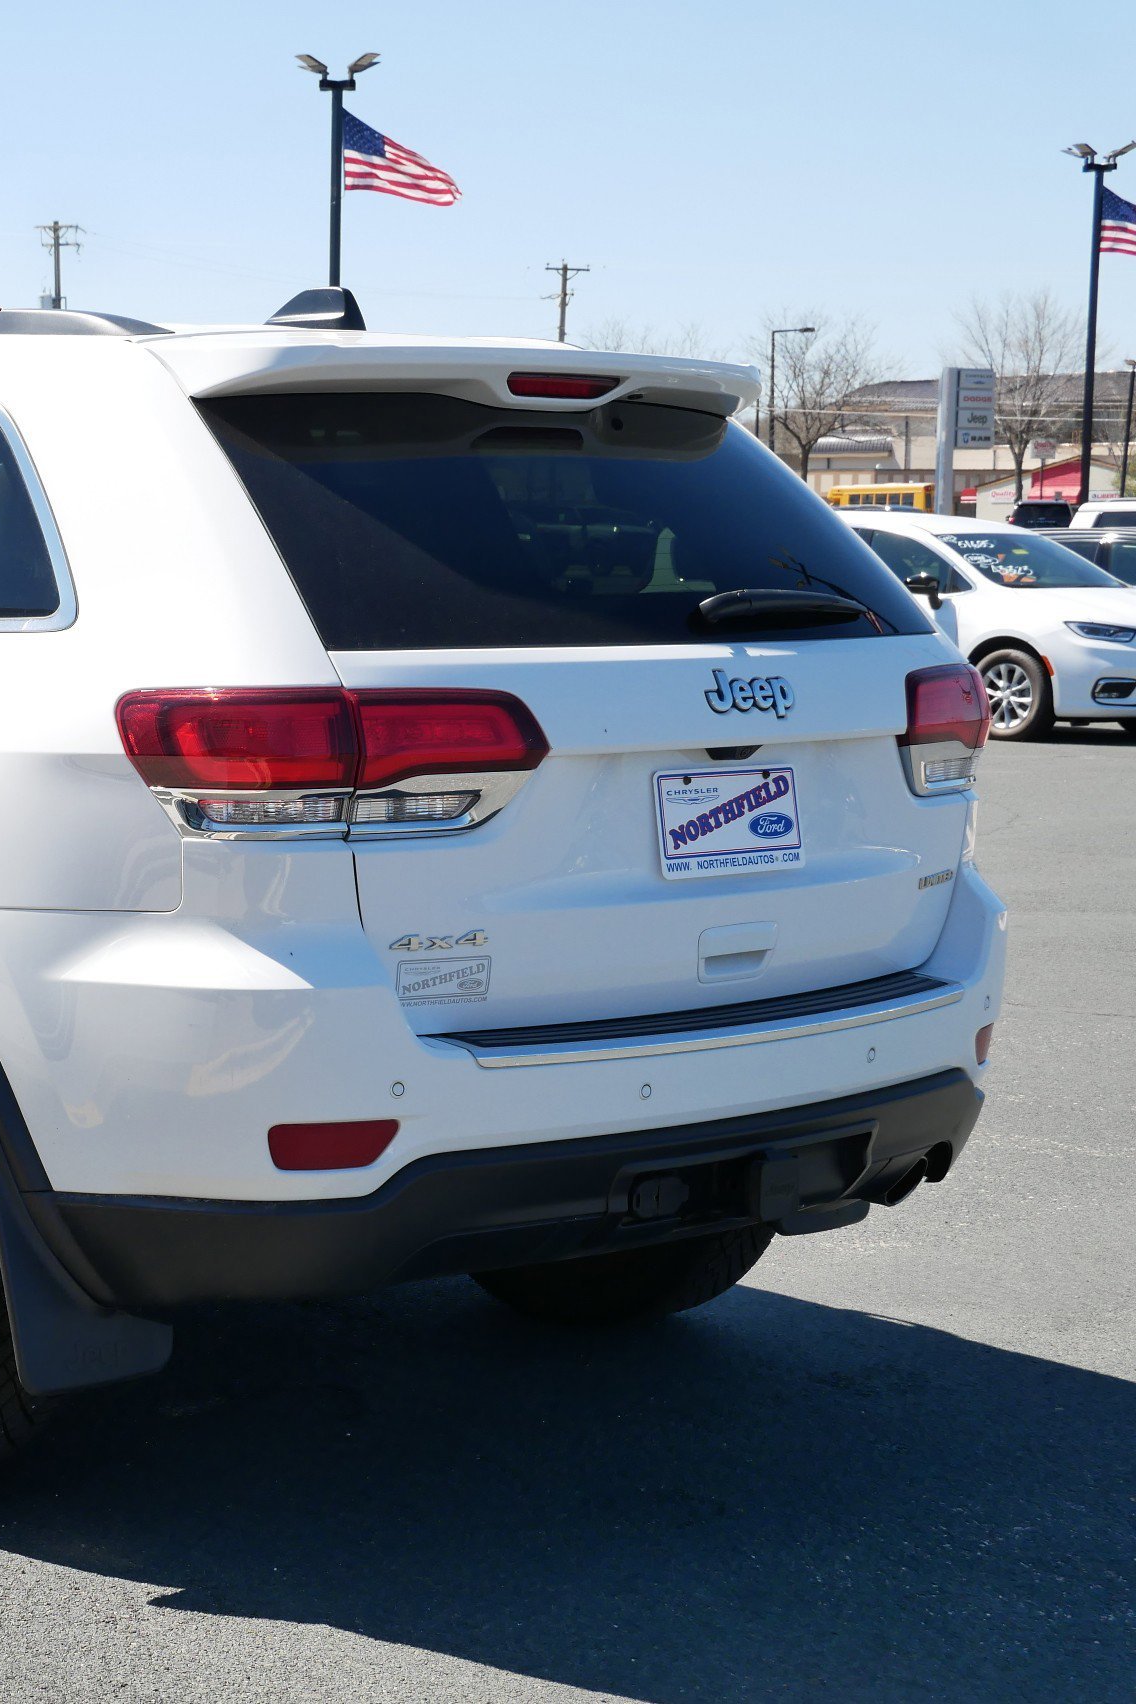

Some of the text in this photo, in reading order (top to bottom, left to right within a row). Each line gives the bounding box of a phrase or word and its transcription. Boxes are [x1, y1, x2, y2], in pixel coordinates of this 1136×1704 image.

[967, 412, 988, 426] Jeep
[704, 668, 794, 720] Jeep
[666, 787, 719, 796] CHRYSLER
[669, 774, 790, 850] NORTHFIELD
[757, 816, 785, 833] Ford
[666, 862, 692, 873] WWW.
[401, 963, 486, 995] NORTHFIELD
